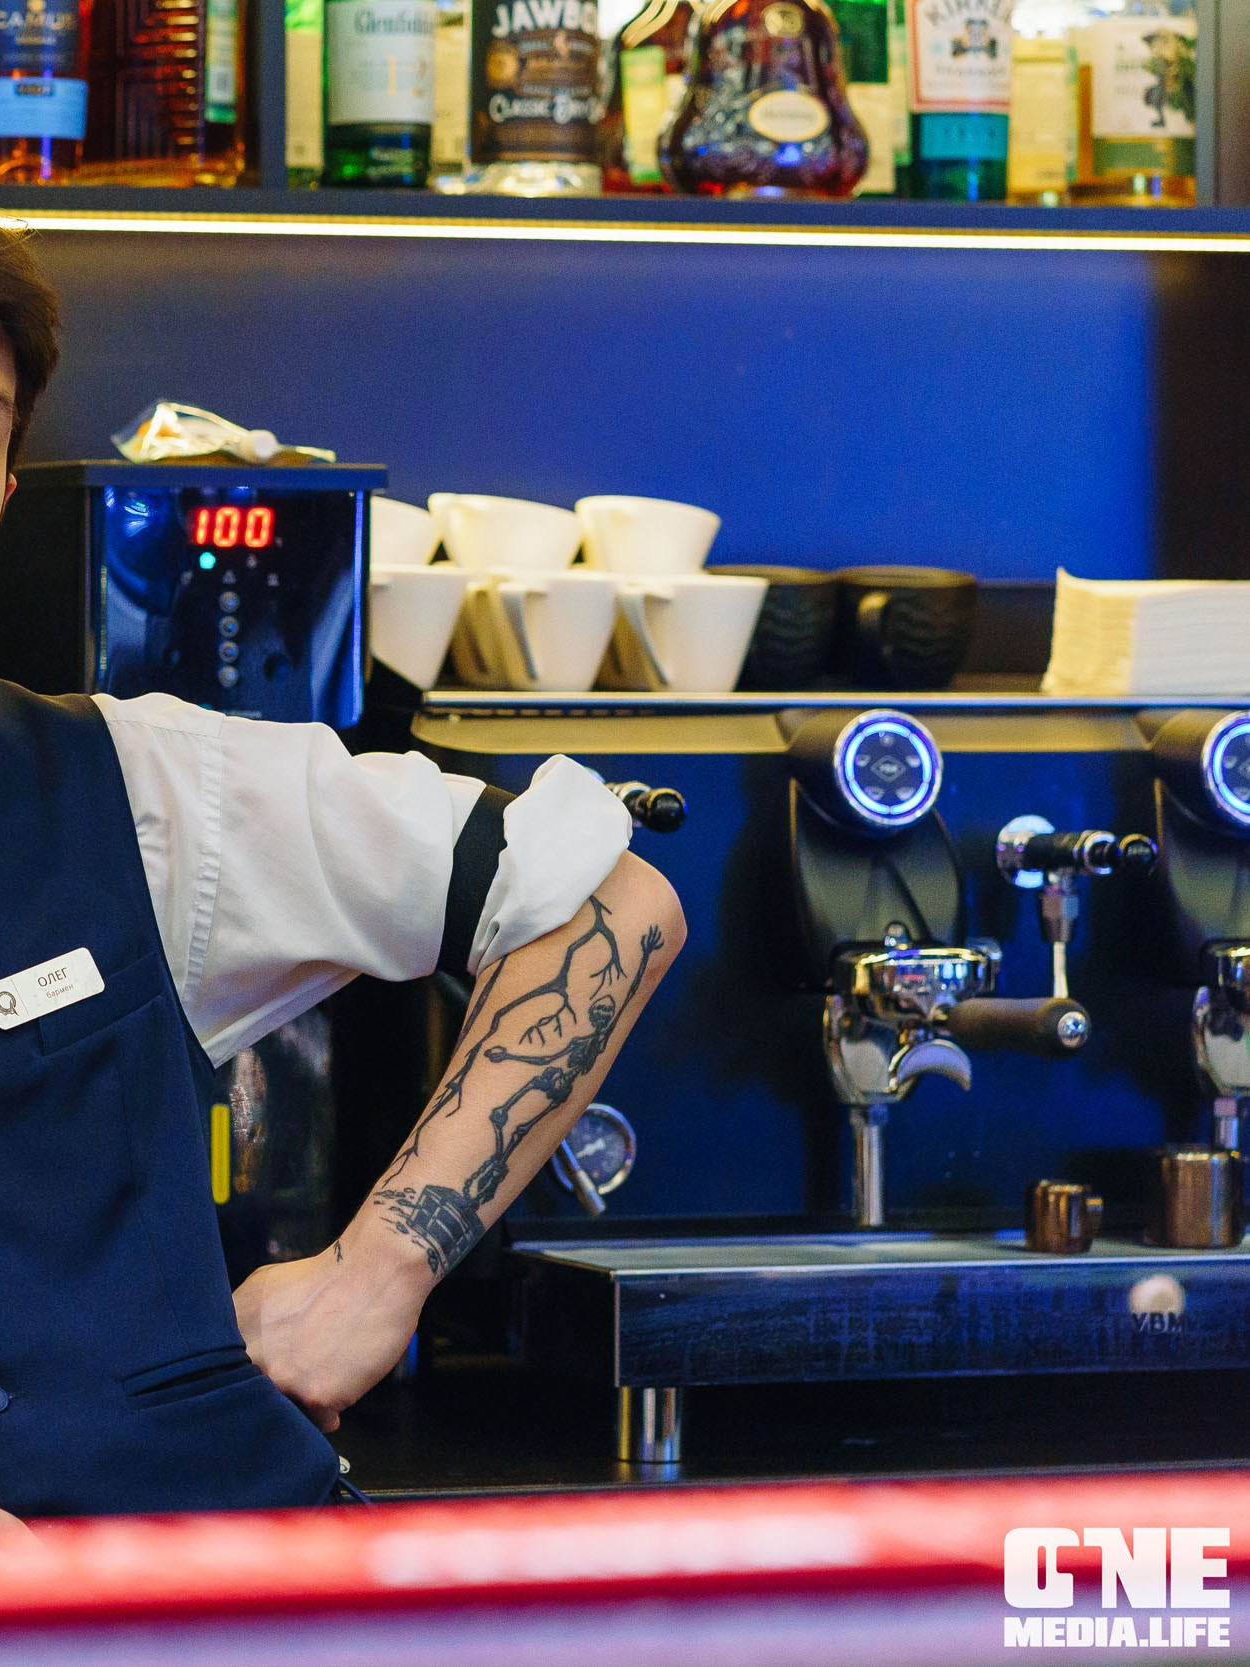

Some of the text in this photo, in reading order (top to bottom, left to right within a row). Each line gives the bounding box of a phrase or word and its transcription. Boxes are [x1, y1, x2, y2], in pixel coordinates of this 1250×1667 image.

[194, 506, 274, 548] 100
[37, 967, 67, 988] ОЛЕГ
[46, 983, 75, 999] бармен
